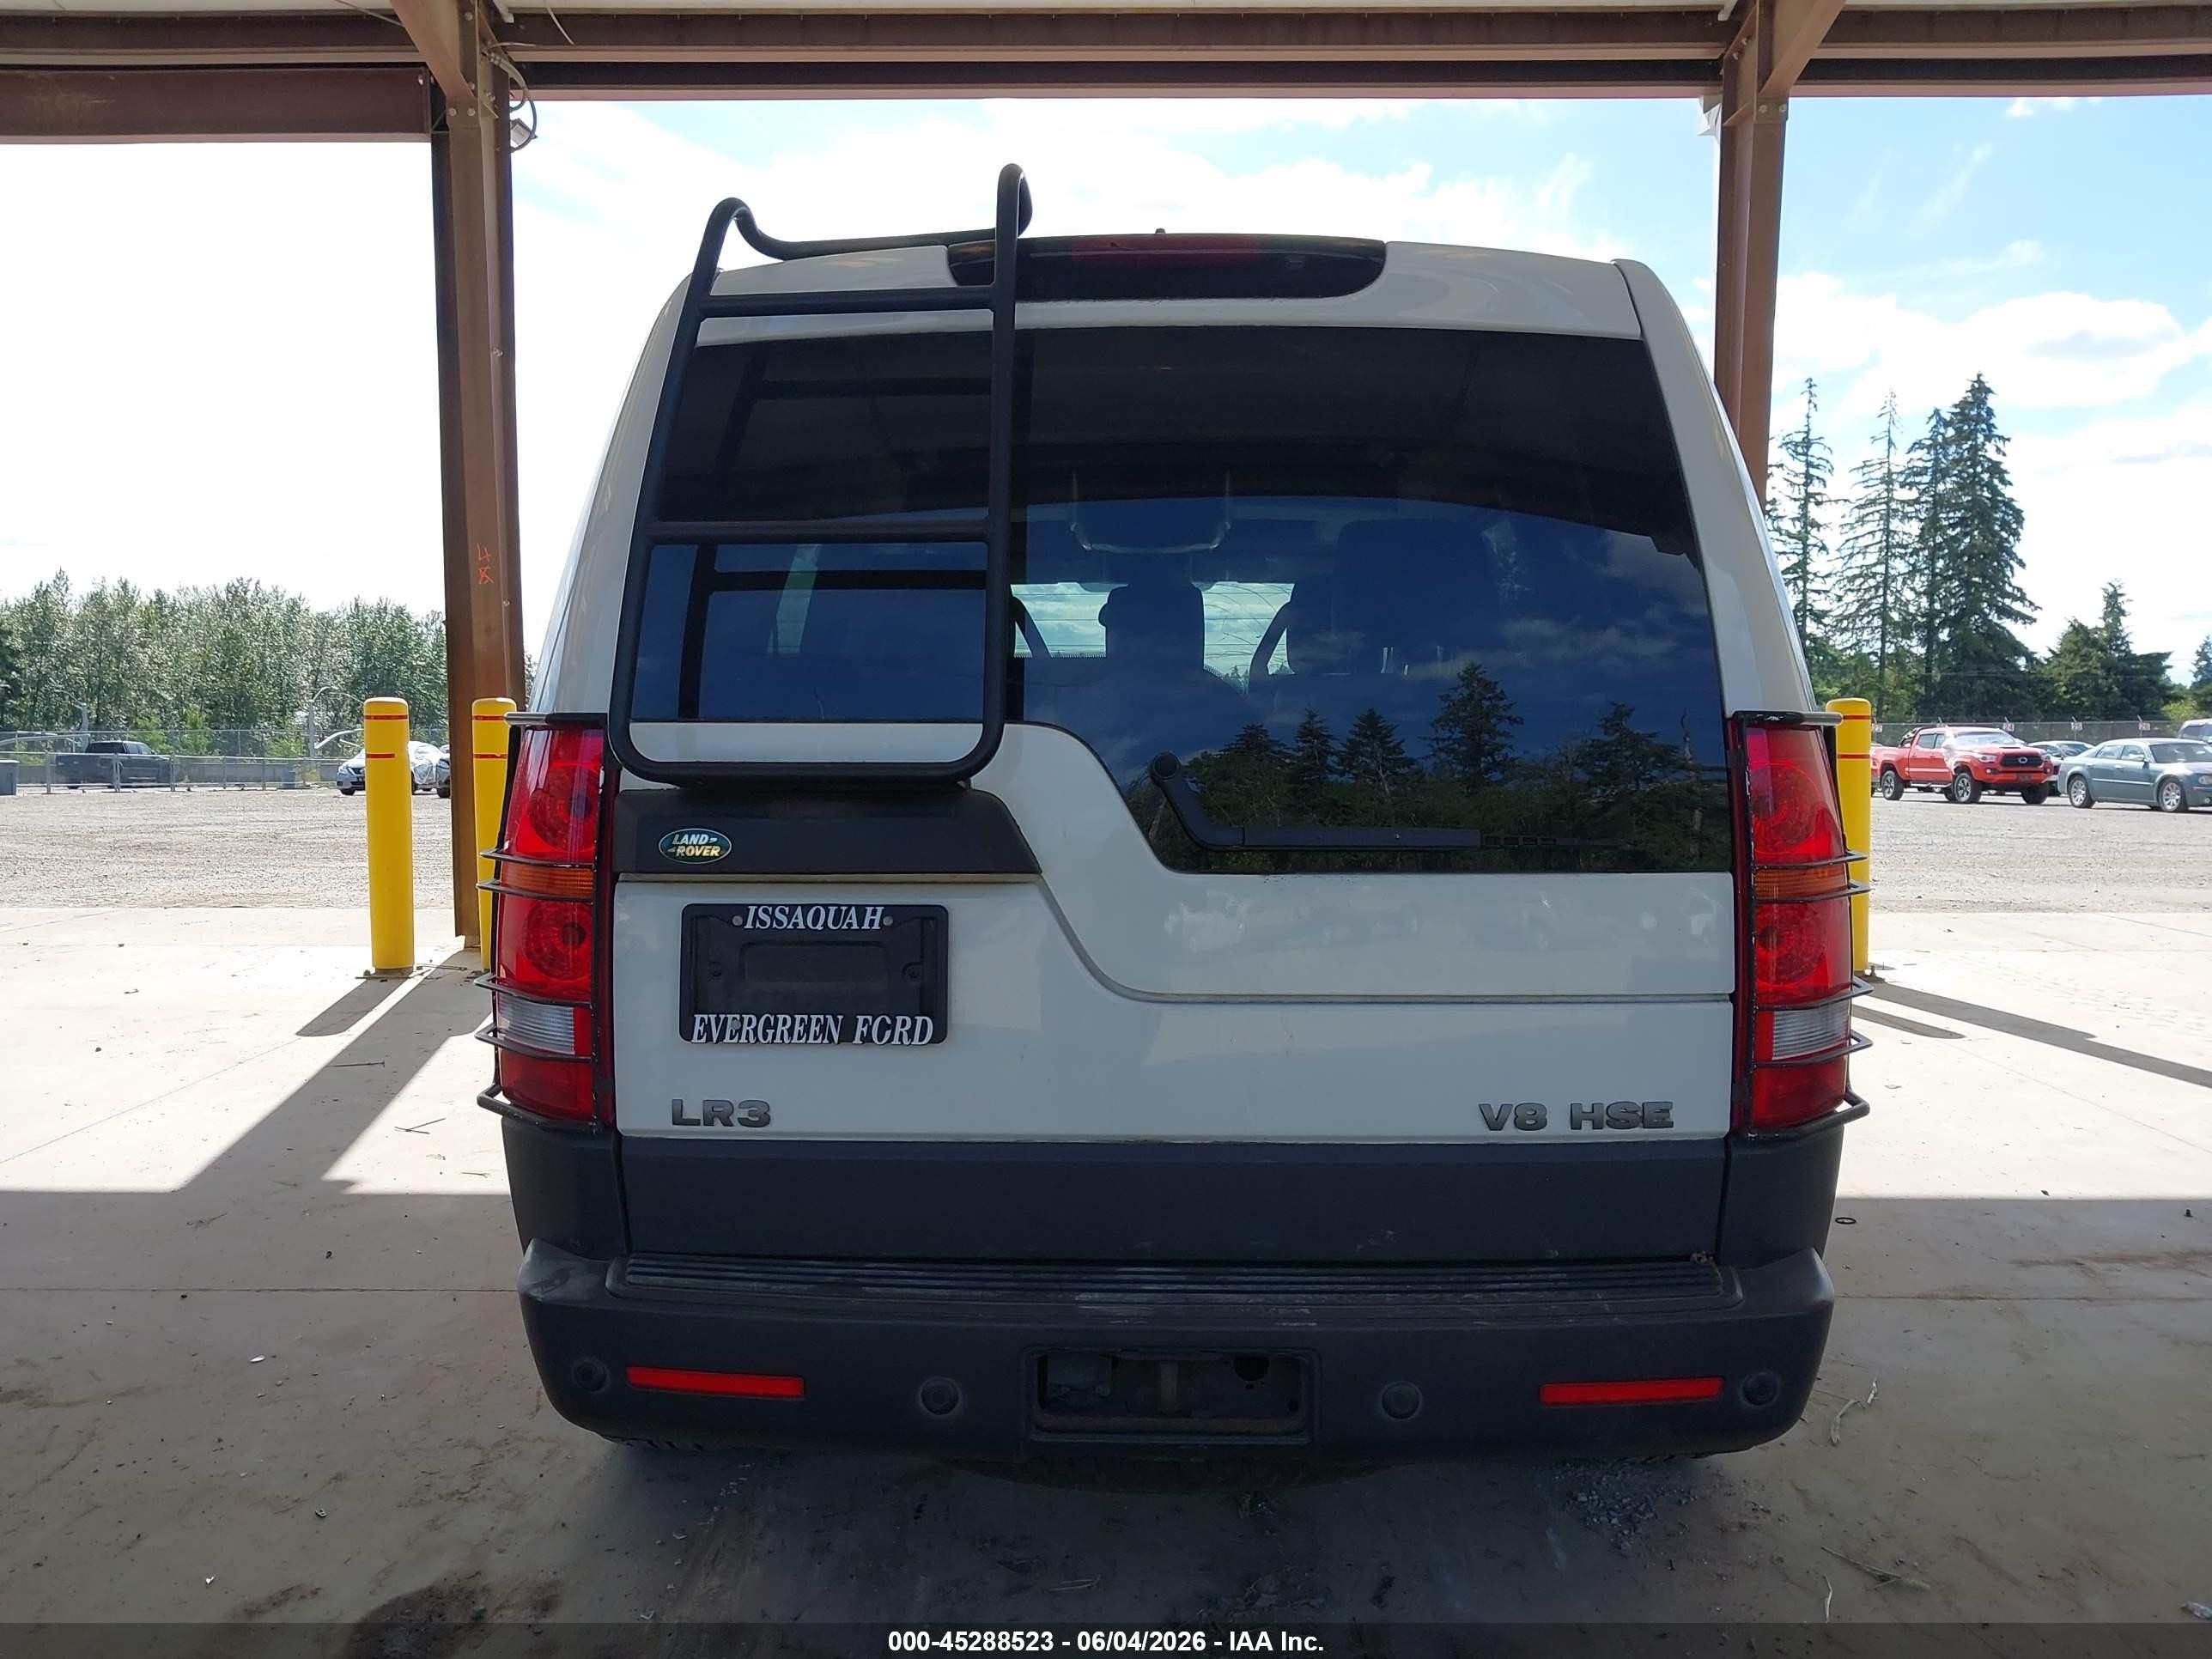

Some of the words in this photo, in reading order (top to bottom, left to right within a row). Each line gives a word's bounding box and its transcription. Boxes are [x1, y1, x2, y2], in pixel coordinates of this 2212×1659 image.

[672, 834, 709, 845] LAND
[676, 845, 721, 857] ROVER
[744, 905, 885, 931] ISSAQUAH
[690, 1013, 844, 1044] EVERGREEN
[672, 1098, 771, 1127] LR3
[1478, 1103, 1547, 1131] V8
[1570, 1101, 1674, 1130] HSE
